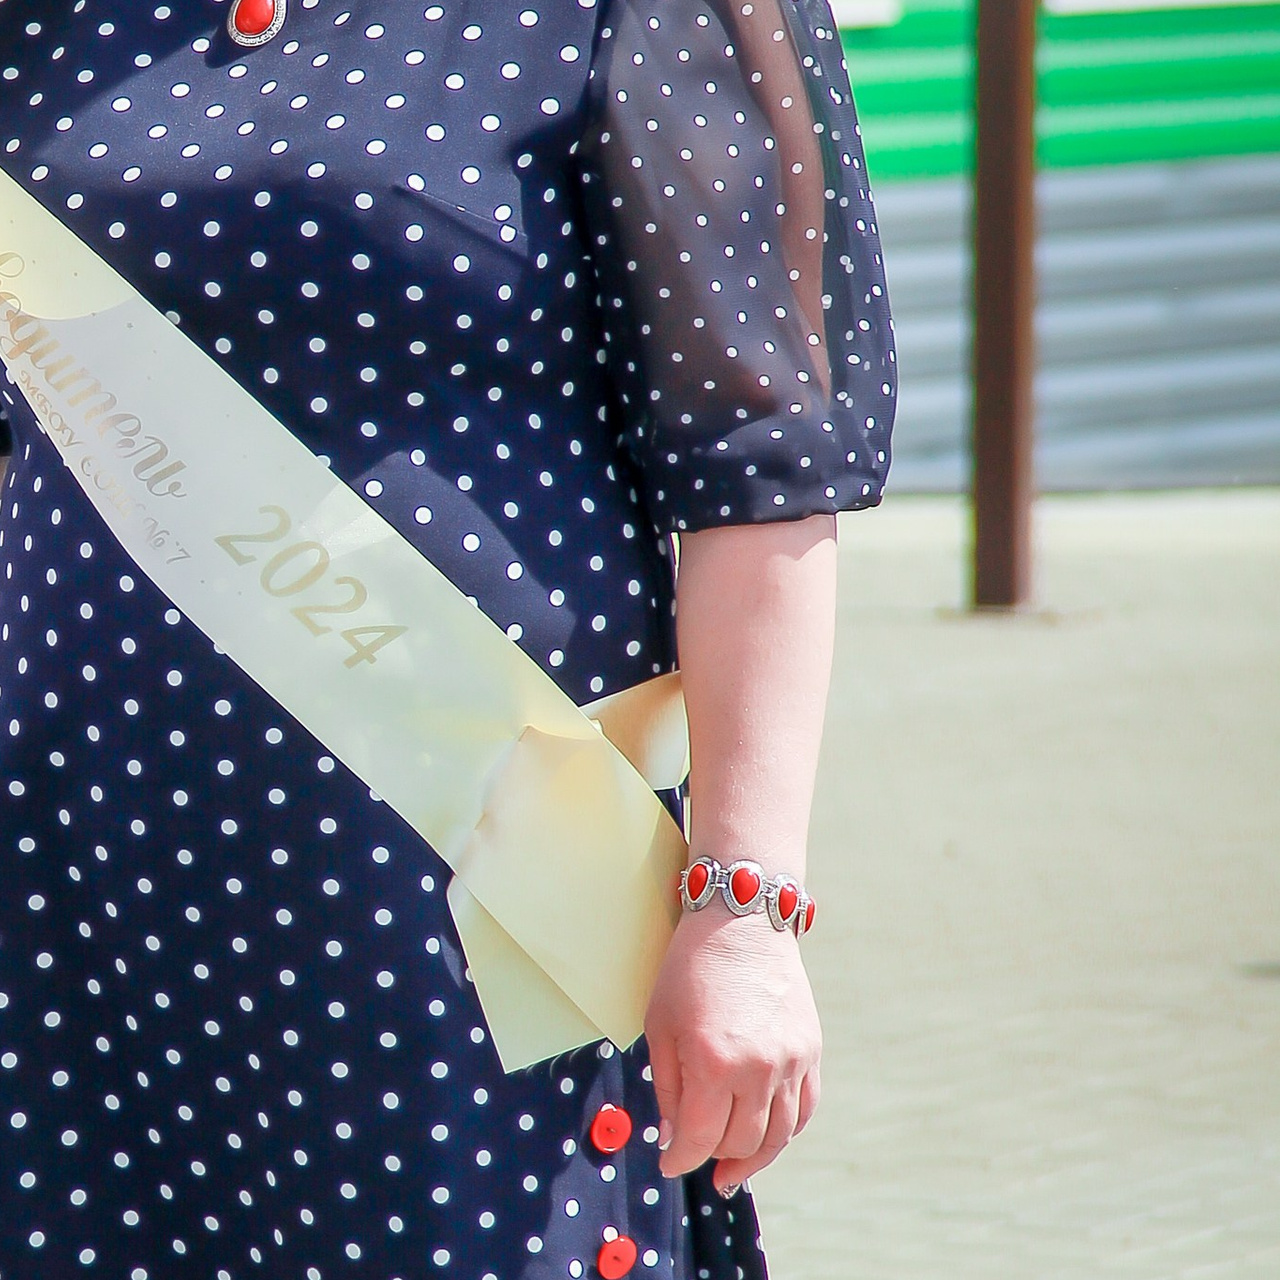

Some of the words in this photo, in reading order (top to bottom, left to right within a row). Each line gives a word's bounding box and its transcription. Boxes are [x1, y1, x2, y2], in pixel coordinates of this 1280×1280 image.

[20, 370, 85, 448] МБОУ
[166, 540, 192, 565] 7
[213, 503, 410, 670] 2024
